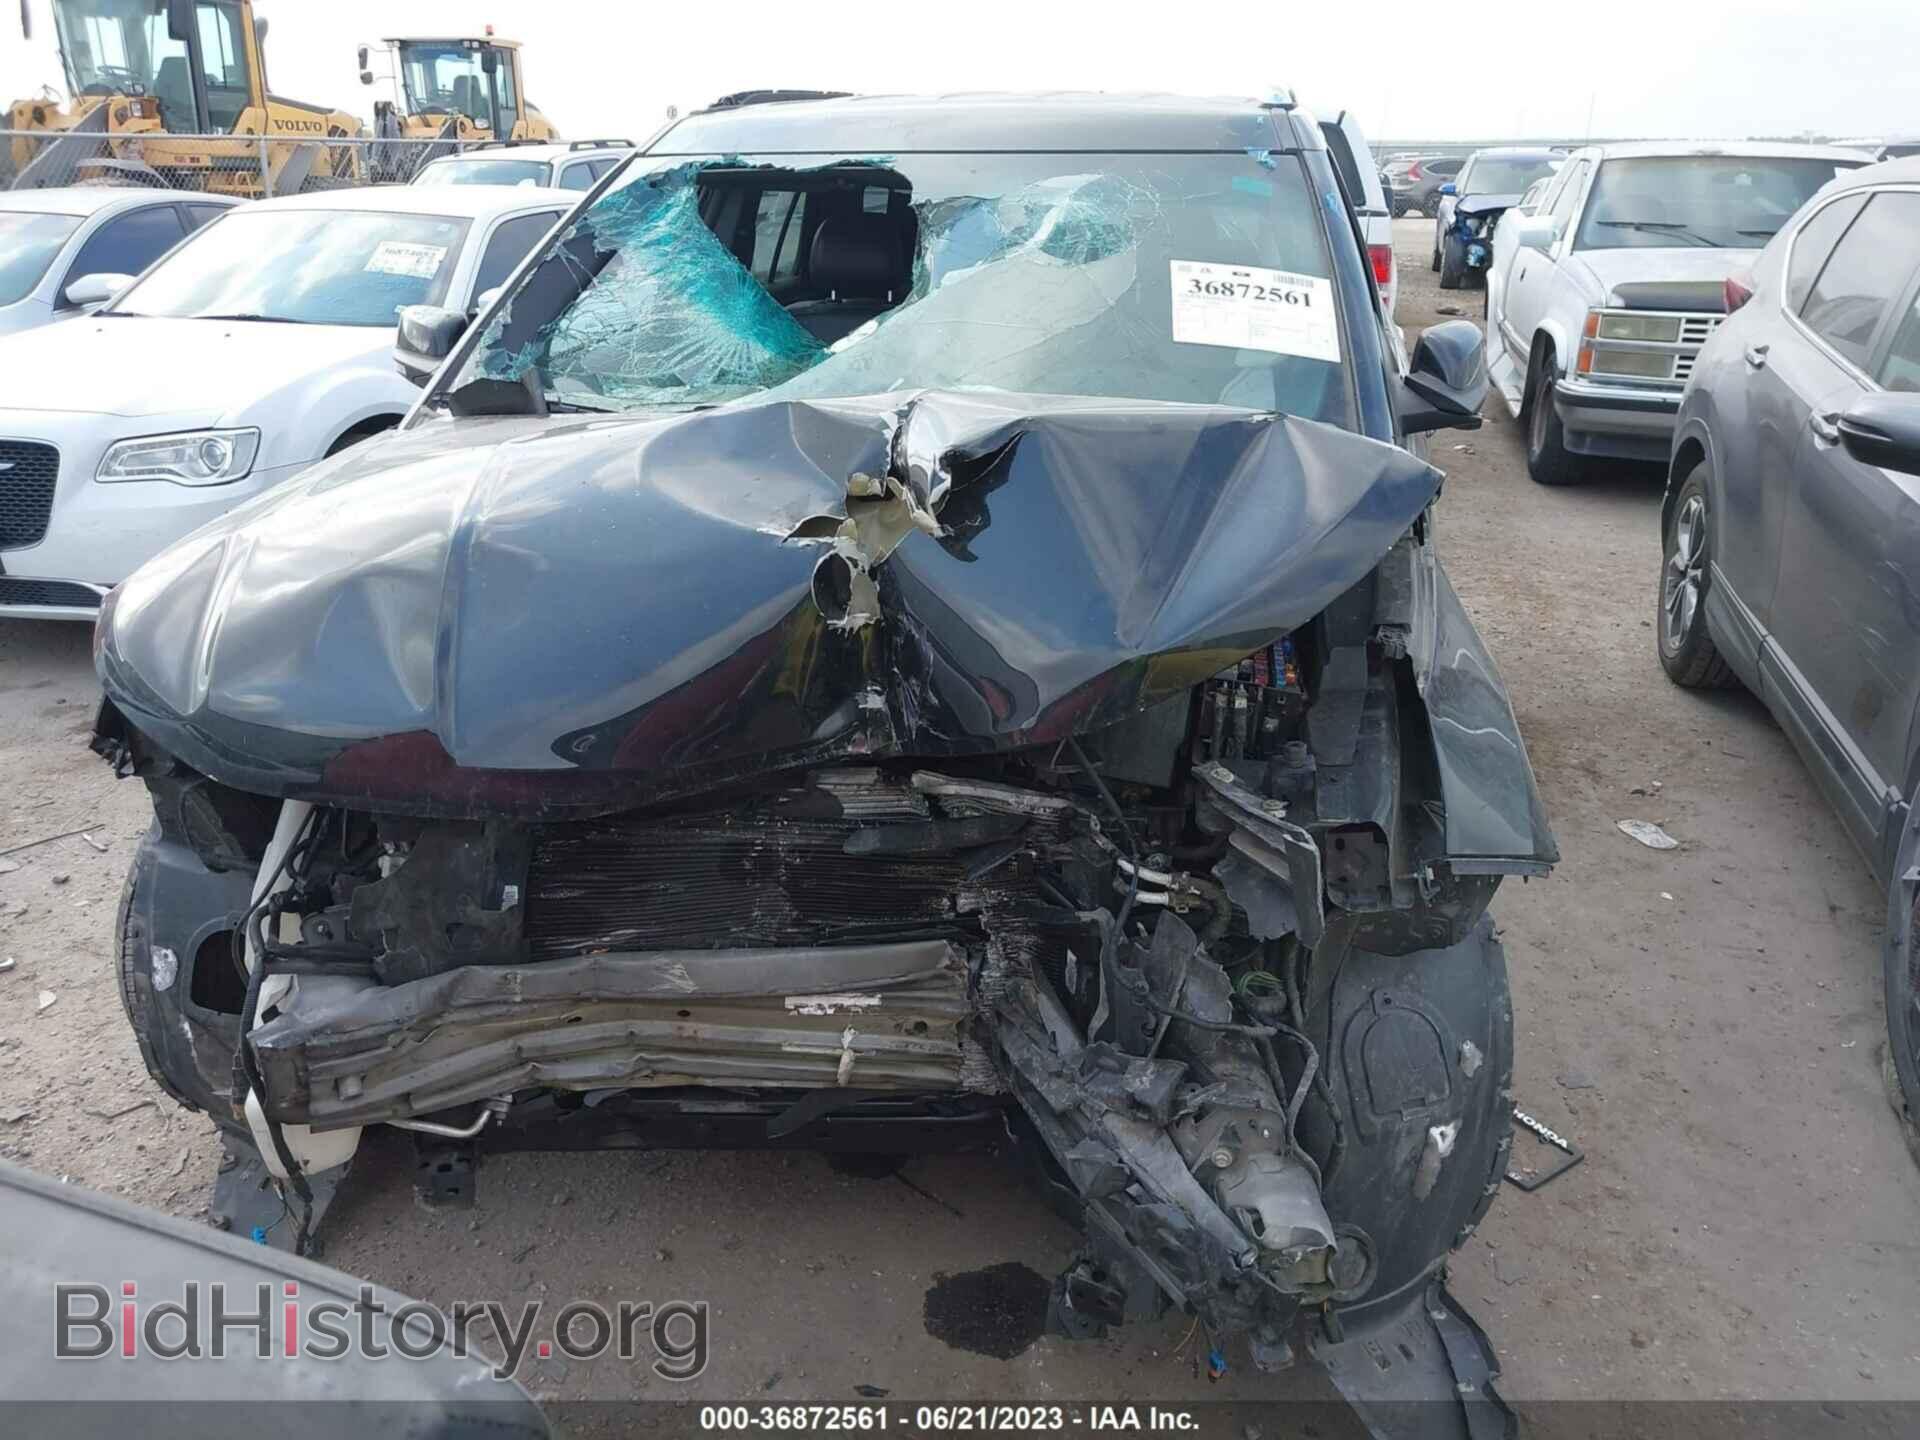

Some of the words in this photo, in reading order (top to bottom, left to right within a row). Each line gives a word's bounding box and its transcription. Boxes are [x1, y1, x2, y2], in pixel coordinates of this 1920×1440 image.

[273, 119, 322, 132] VOLVO
[1187, 278, 1314, 308] 36872561
[1512, 1108, 1568, 1149] HONDA
